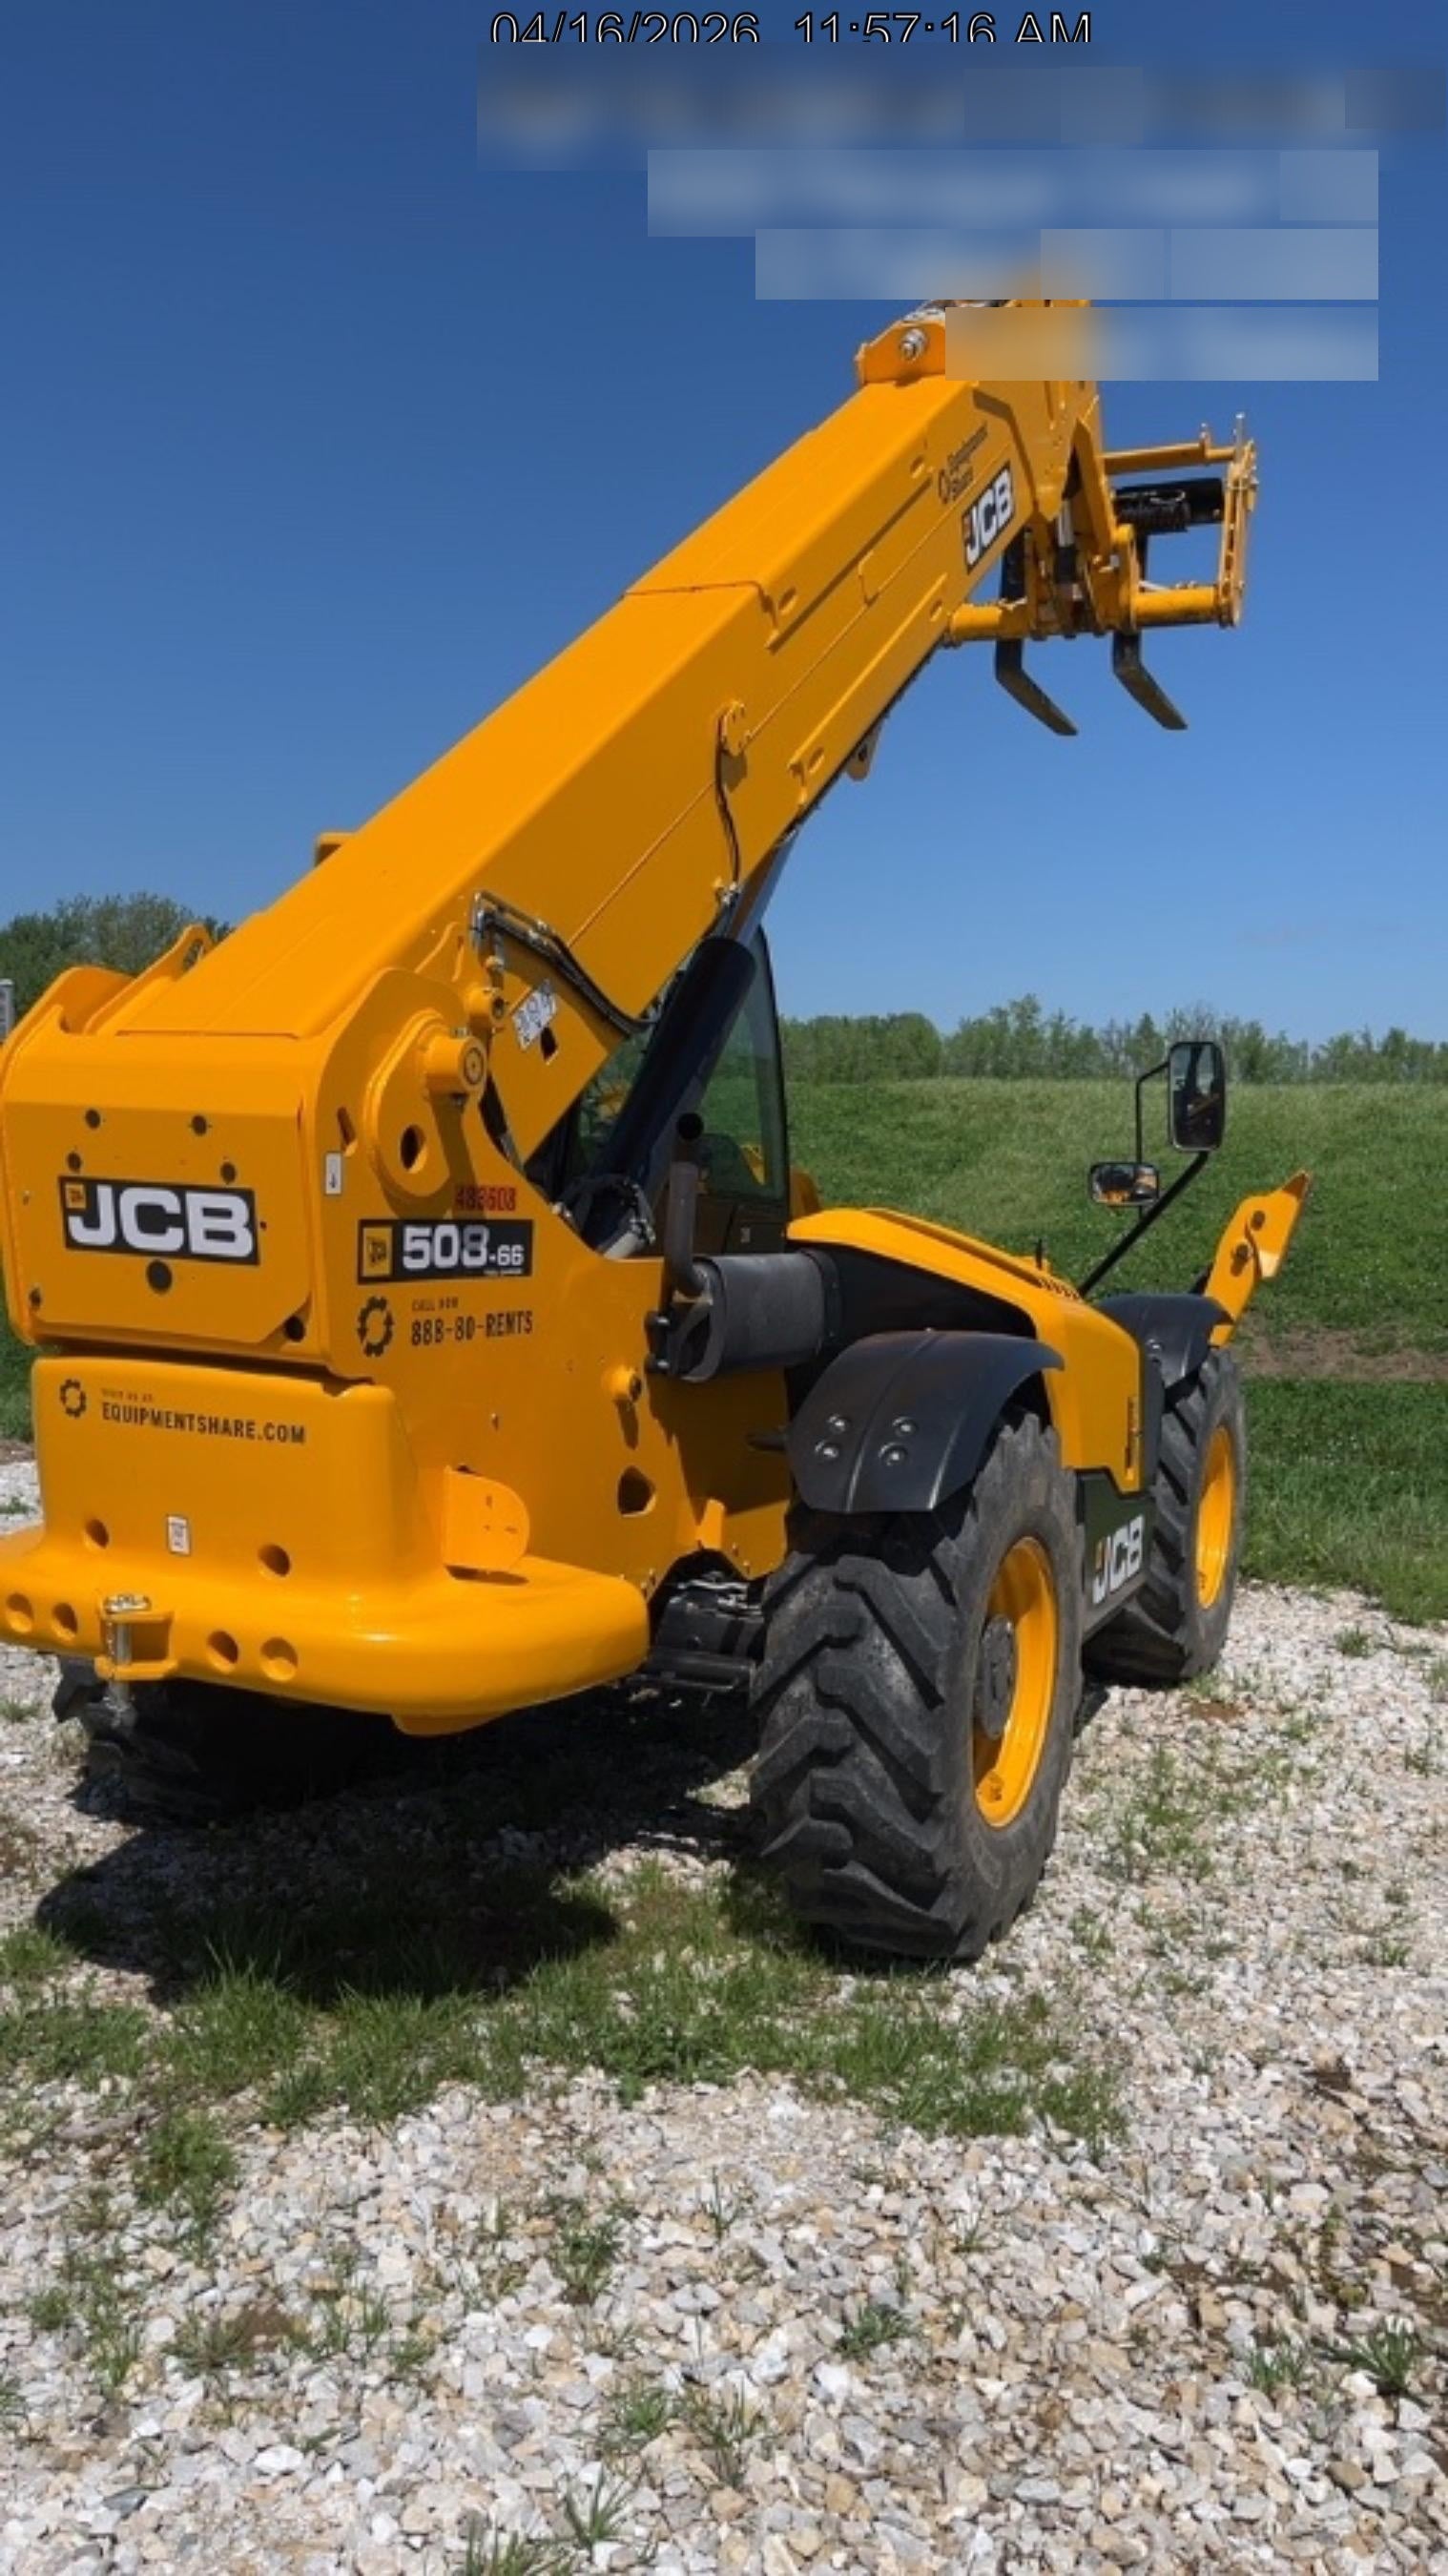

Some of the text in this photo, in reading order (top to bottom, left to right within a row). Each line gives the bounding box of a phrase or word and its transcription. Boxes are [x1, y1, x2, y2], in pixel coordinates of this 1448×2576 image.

[966, 468, 1014, 565] JCB
[68, 1184, 253, 1257] JCB
[403, 1224, 525, 1269] 508-66
[411, 1310, 533, 1346] 888-80-RENTS
[102, 1402, 305, 1444] EQUIPMENTSHARE.COM
[1092, 1515, 1144, 1605] JCB
